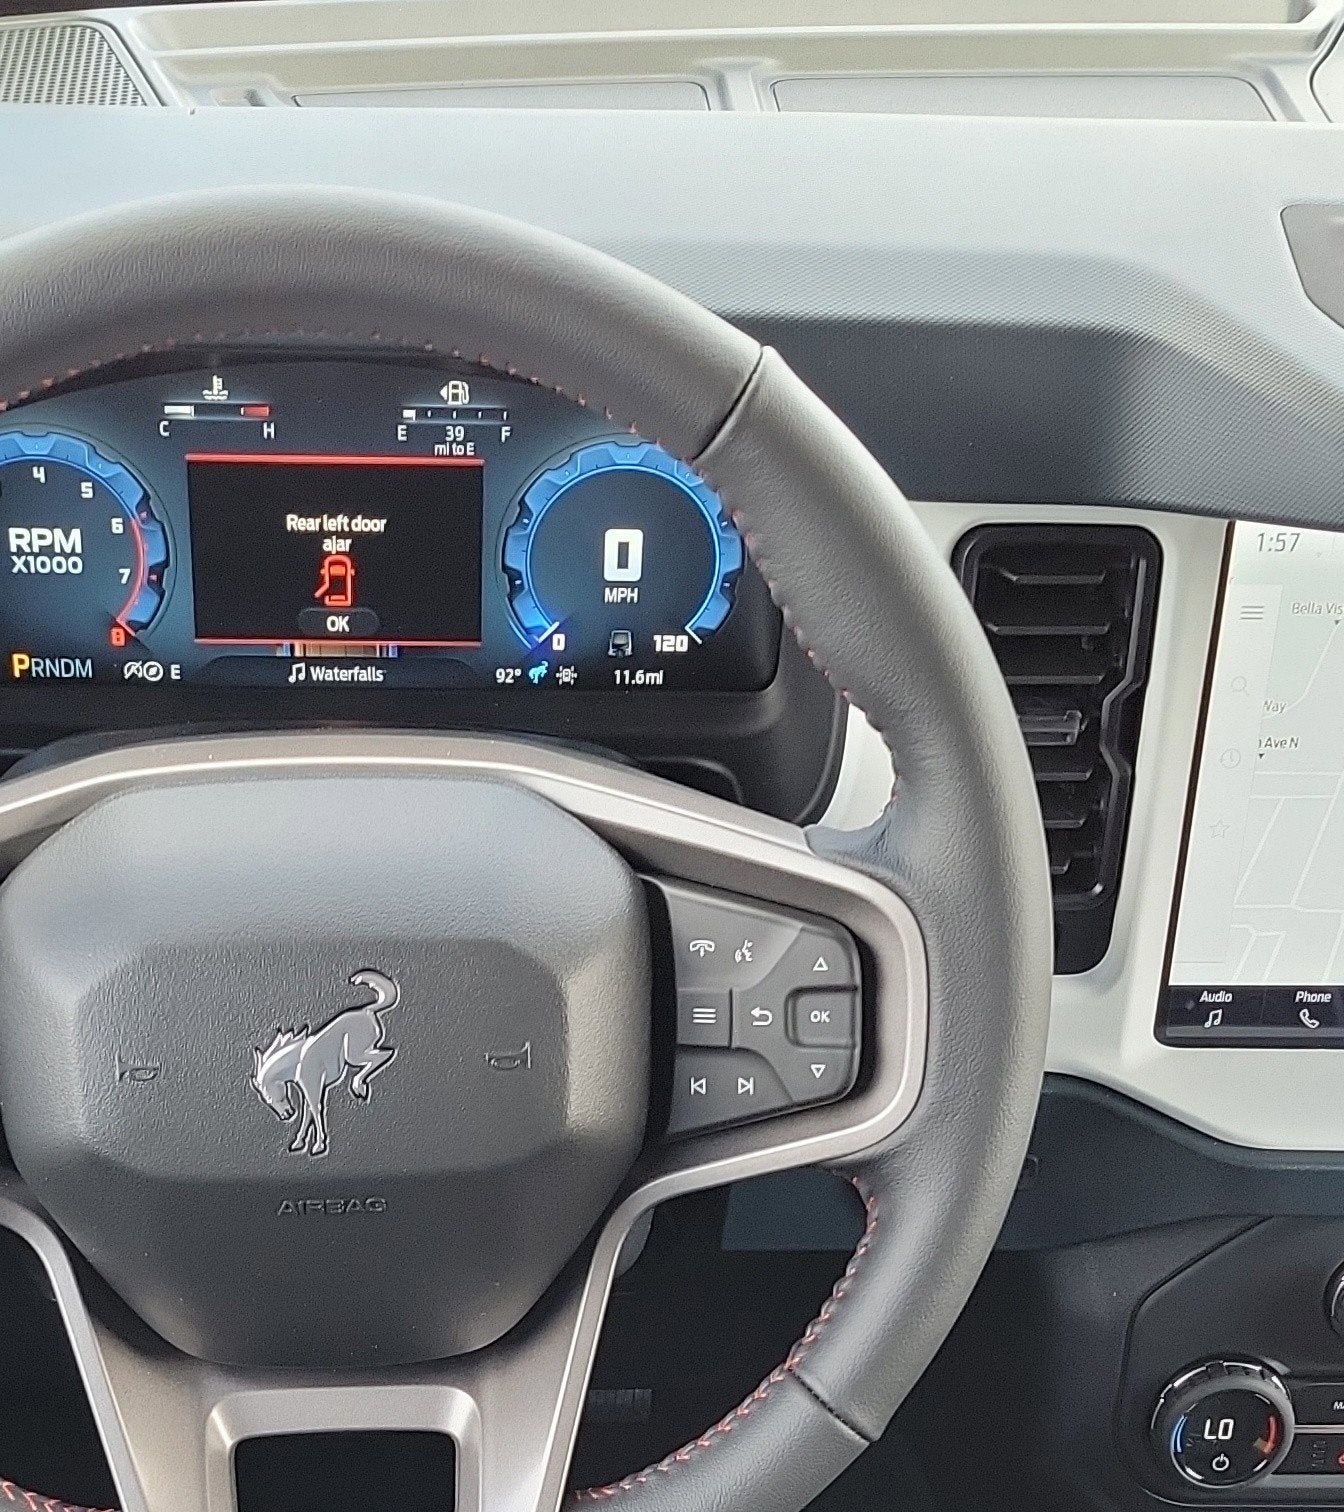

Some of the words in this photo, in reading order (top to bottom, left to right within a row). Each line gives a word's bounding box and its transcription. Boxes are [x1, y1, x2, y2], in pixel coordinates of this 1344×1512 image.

[159, 421, 170, 437] C
[262, 422, 275, 439] H
[397, 426, 407, 441] E
[445, 426, 465, 442] 39
[501, 427, 511, 443] F
[434, 442, 450, 456] mi
[452, 442, 464, 456] to
[466, 442, 475, 456] E
[33, 467, 46, 483] 4
[81, 482, 93, 498] 5
[111, 518, 124, 534] 6
[286, 516, 321, 532] Rear
[323, 515, 349, 532] left
[351, 515, 387, 532] door
[8, 528, 83, 554] RPM
[322, 537, 352, 554] ajar
[1257, 533, 1301, 553] 1:57
[603, 529, 643, 582] 0
[11, 556, 83, 574] X1000
[119, 569, 131, 584] 7
[604, 587, 639, 604] MPH
[1291, 602, 1322, 615] Bella
[326, 616, 350, 633] OK
[110, 629, 126, 646] 8
[552, 634, 566, 651] 0
[654, 635, 688, 653] 120
[171, 665, 181, 680] E
[310, 666, 385, 683] Waterfalls
[495, 668, 522, 684] 92°
[1264, 736, 1287, 749] Ave
[1289, 736, 1300, 749] N
[1199, 990, 1233, 1003] Audio
[1295, 990, 1332, 1004] Phone
[810, 1010, 831, 1023] OK
[276, 1197, 388, 1216] AIRBAG
[1203, 1418, 1234, 1440] LO
